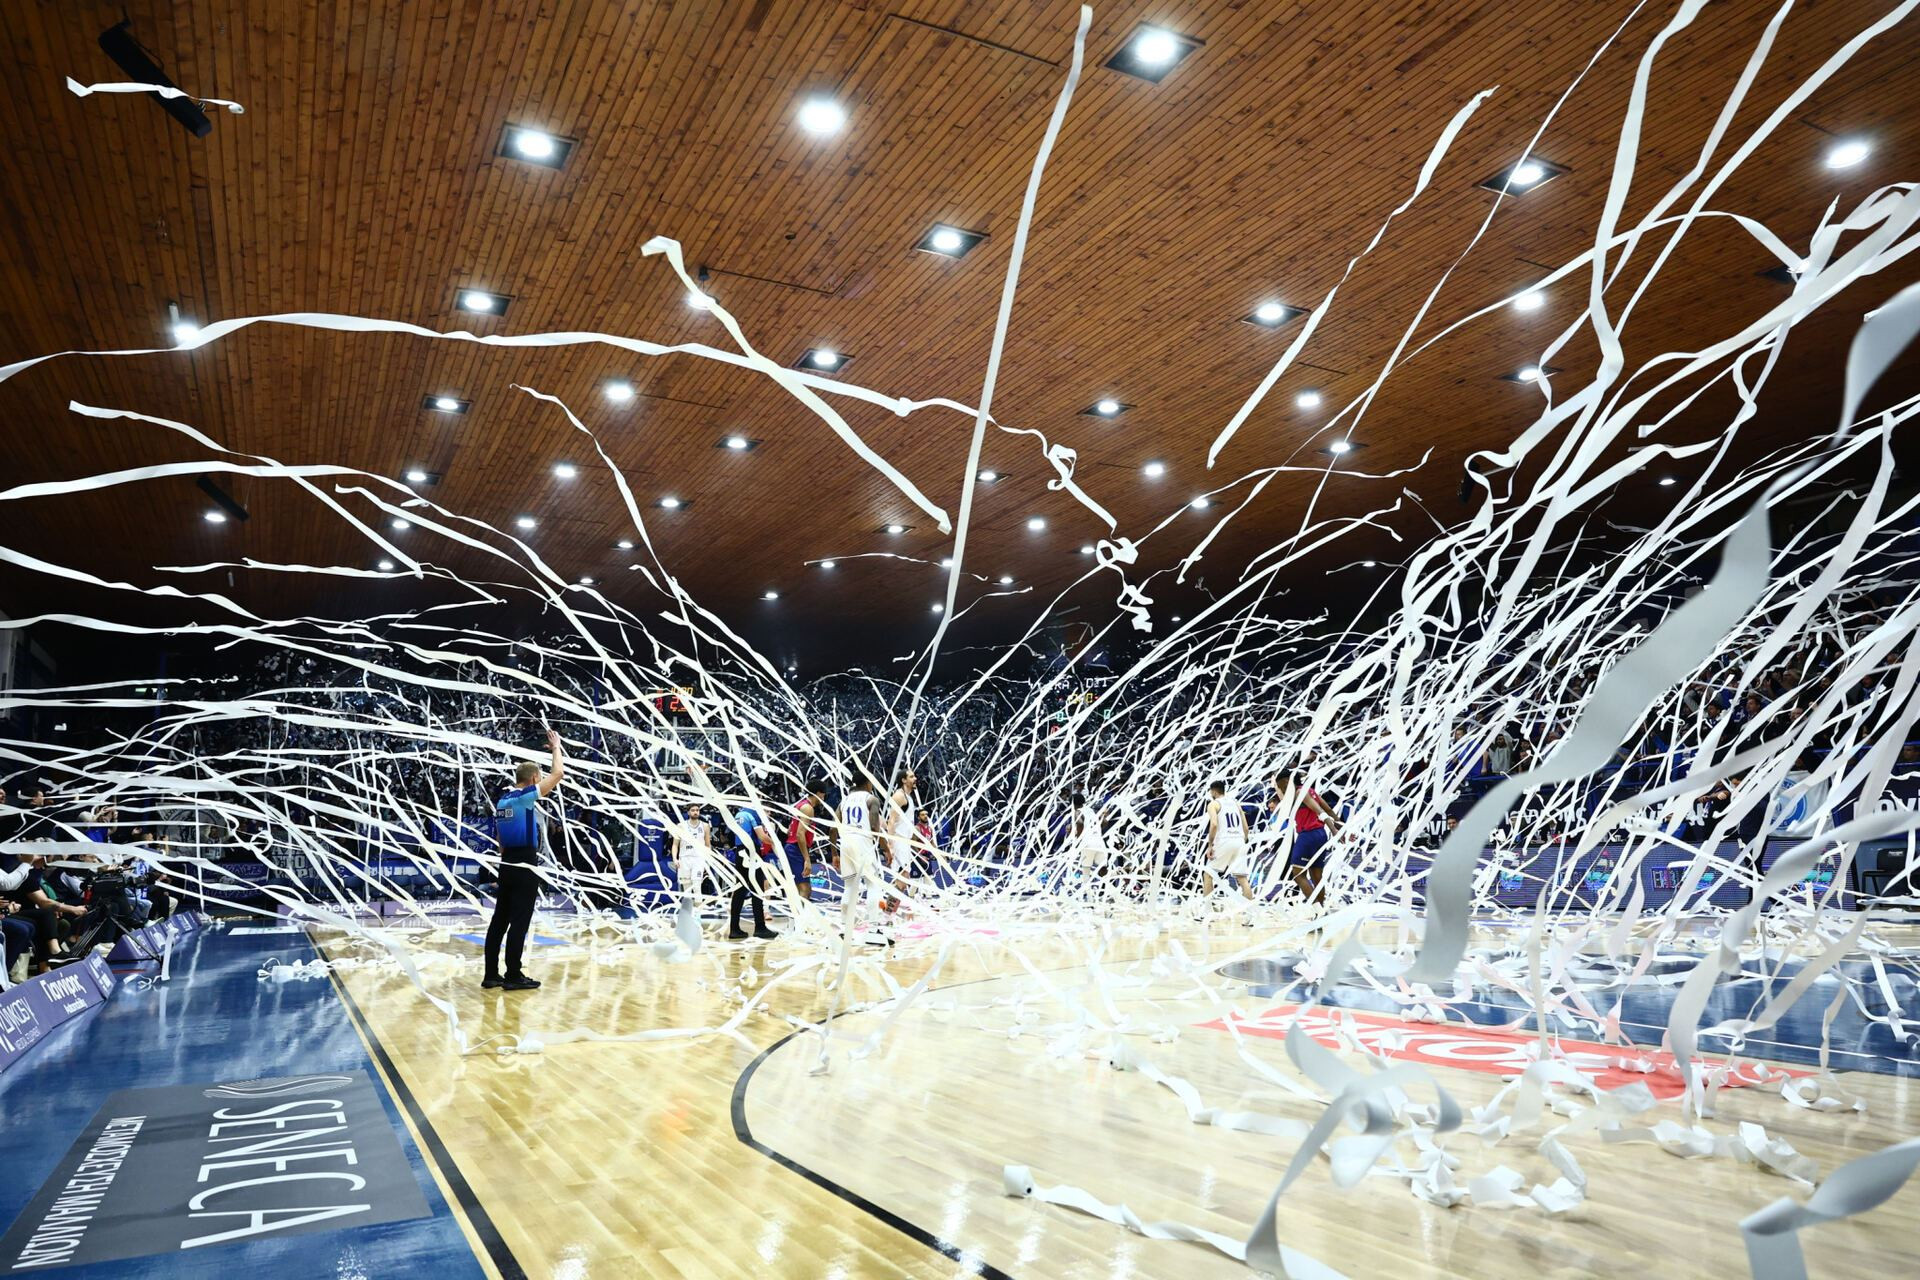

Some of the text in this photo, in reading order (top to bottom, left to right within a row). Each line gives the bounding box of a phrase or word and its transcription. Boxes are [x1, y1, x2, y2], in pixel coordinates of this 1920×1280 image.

[846, 806, 863, 825] 19
[1224, 812, 1240, 829] 10
[12, 1115, 148, 1269] ΜΕΤΑΜΟΣΧΕΥΣΗ ΜΑΛΛΙΩΝ
[180, 1099, 371, 1249] SENECA
